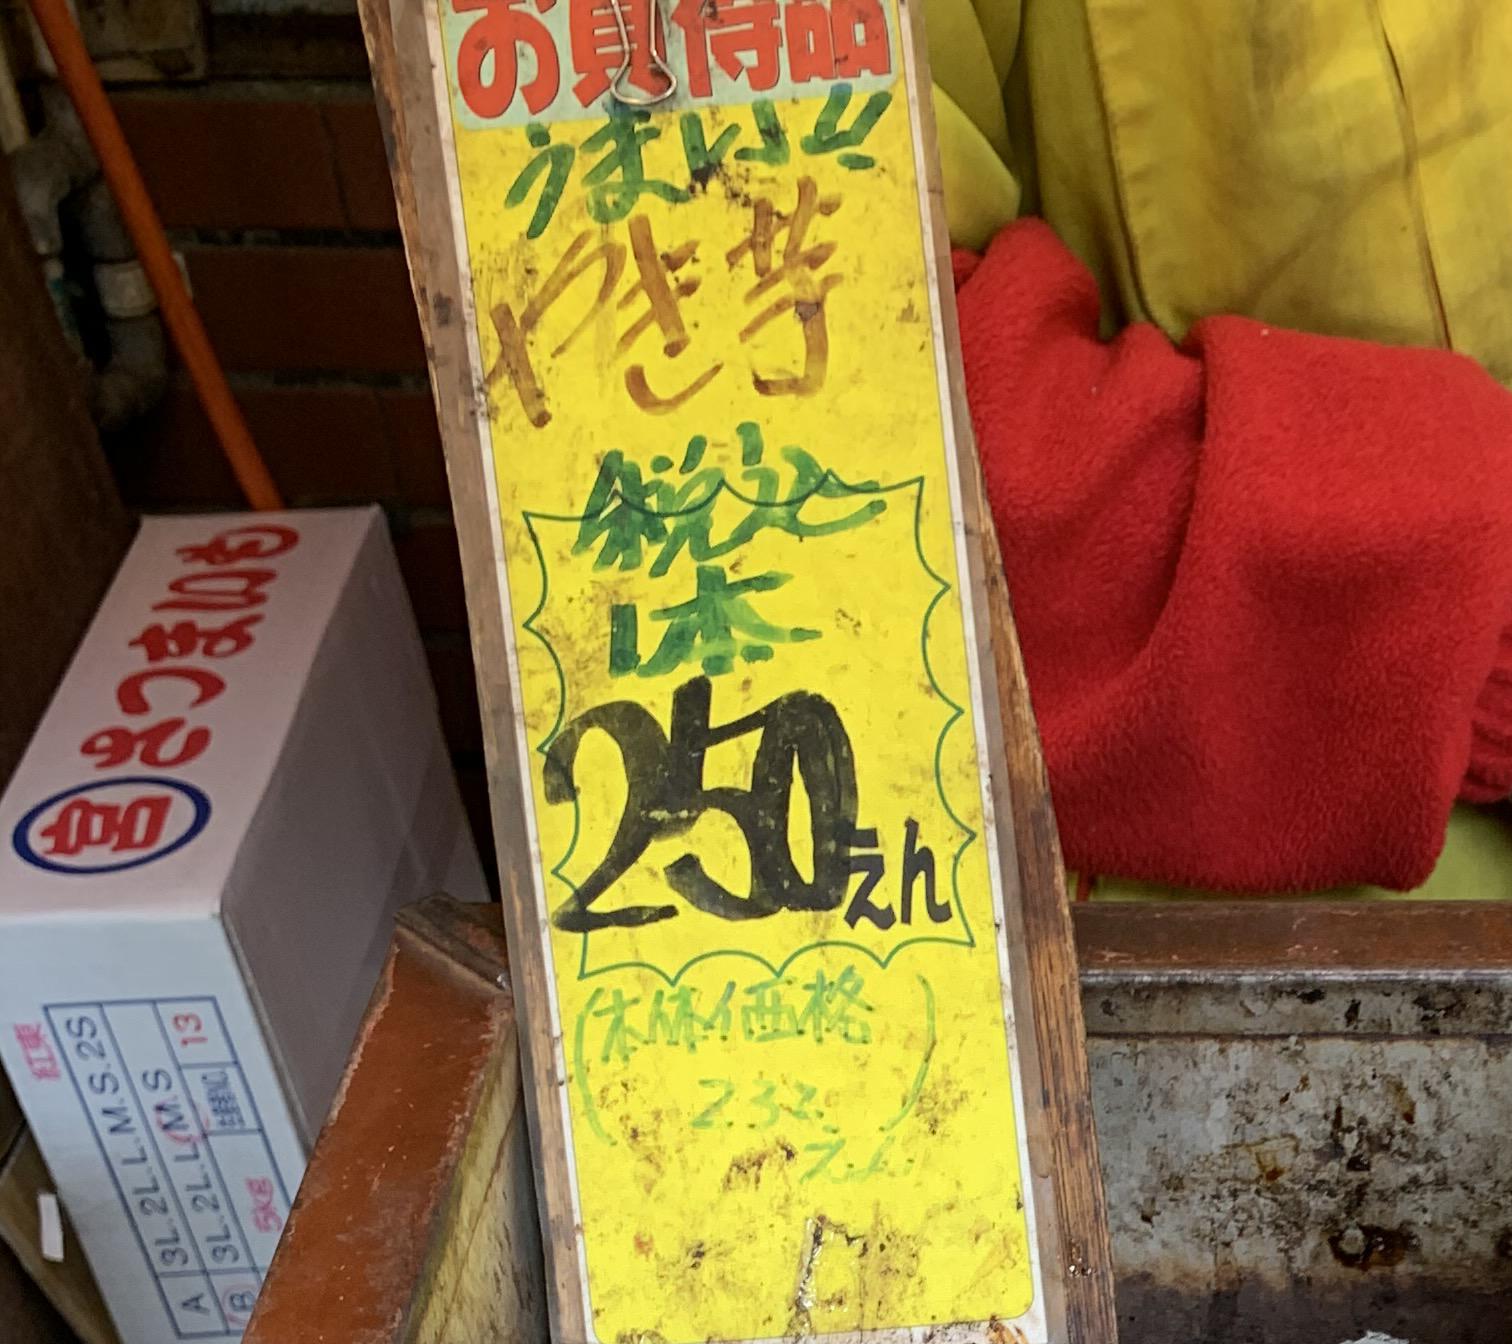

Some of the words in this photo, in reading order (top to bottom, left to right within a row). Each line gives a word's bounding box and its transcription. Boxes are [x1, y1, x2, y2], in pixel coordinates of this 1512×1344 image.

[483, 176, 844, 428] やき芋
[573, 422, 886, 578] 税込
[79, 524, 300, 769] さつまいも
[173, 1013, 209, 1050] 13
[175, 1290, 211, 1316] A
